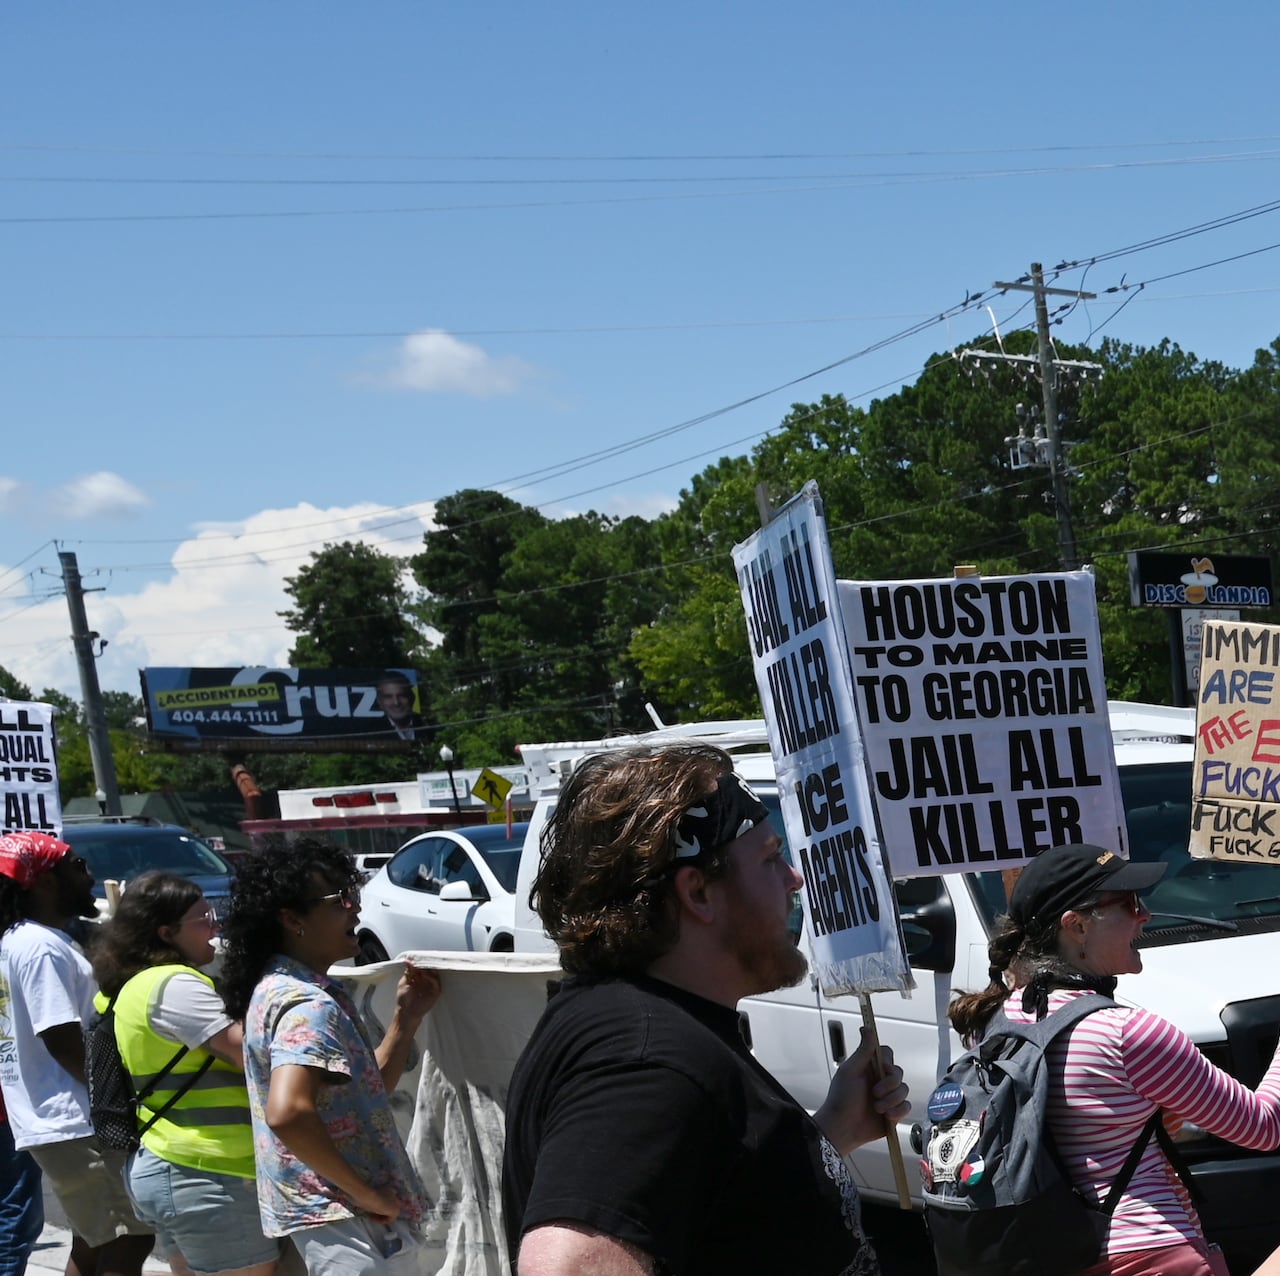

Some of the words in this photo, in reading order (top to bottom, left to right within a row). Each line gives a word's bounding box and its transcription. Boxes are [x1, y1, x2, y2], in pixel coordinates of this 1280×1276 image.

[743, 548, 789, 658] JAIL
[780, 521, 828, 632] ALL
[860, 580, 1070, 641] HOUSTON
[855, 645, 924, 668] TO
[934, 638, 1088, 666] MAINE
[158, 686, 276, 706] ¿ACCIDENTADO?
[767, 638, 840, 757] KILLER
[857, 675, 911, 724] TO
[922, 667, 1095, 721] GEORGIA
[1202, 669, 1275, 704] ARE
[171, 711, 279, 723] 404.444.1111
[1199, 710, 1253, 754] THE
[875, 733, 994, 800] JAIL
[1008, 727, 1102, 791] ALL
[5, 792, 54, 829] ALL
[795, 762, 849, 838] ICE
[1193, 800, 1276, 837] FUCK
[909, 796, 1083, 867] KILLER
[1210, 836, 1264, 858] FUCK
[799, 826, 880, 938] AGENTS
